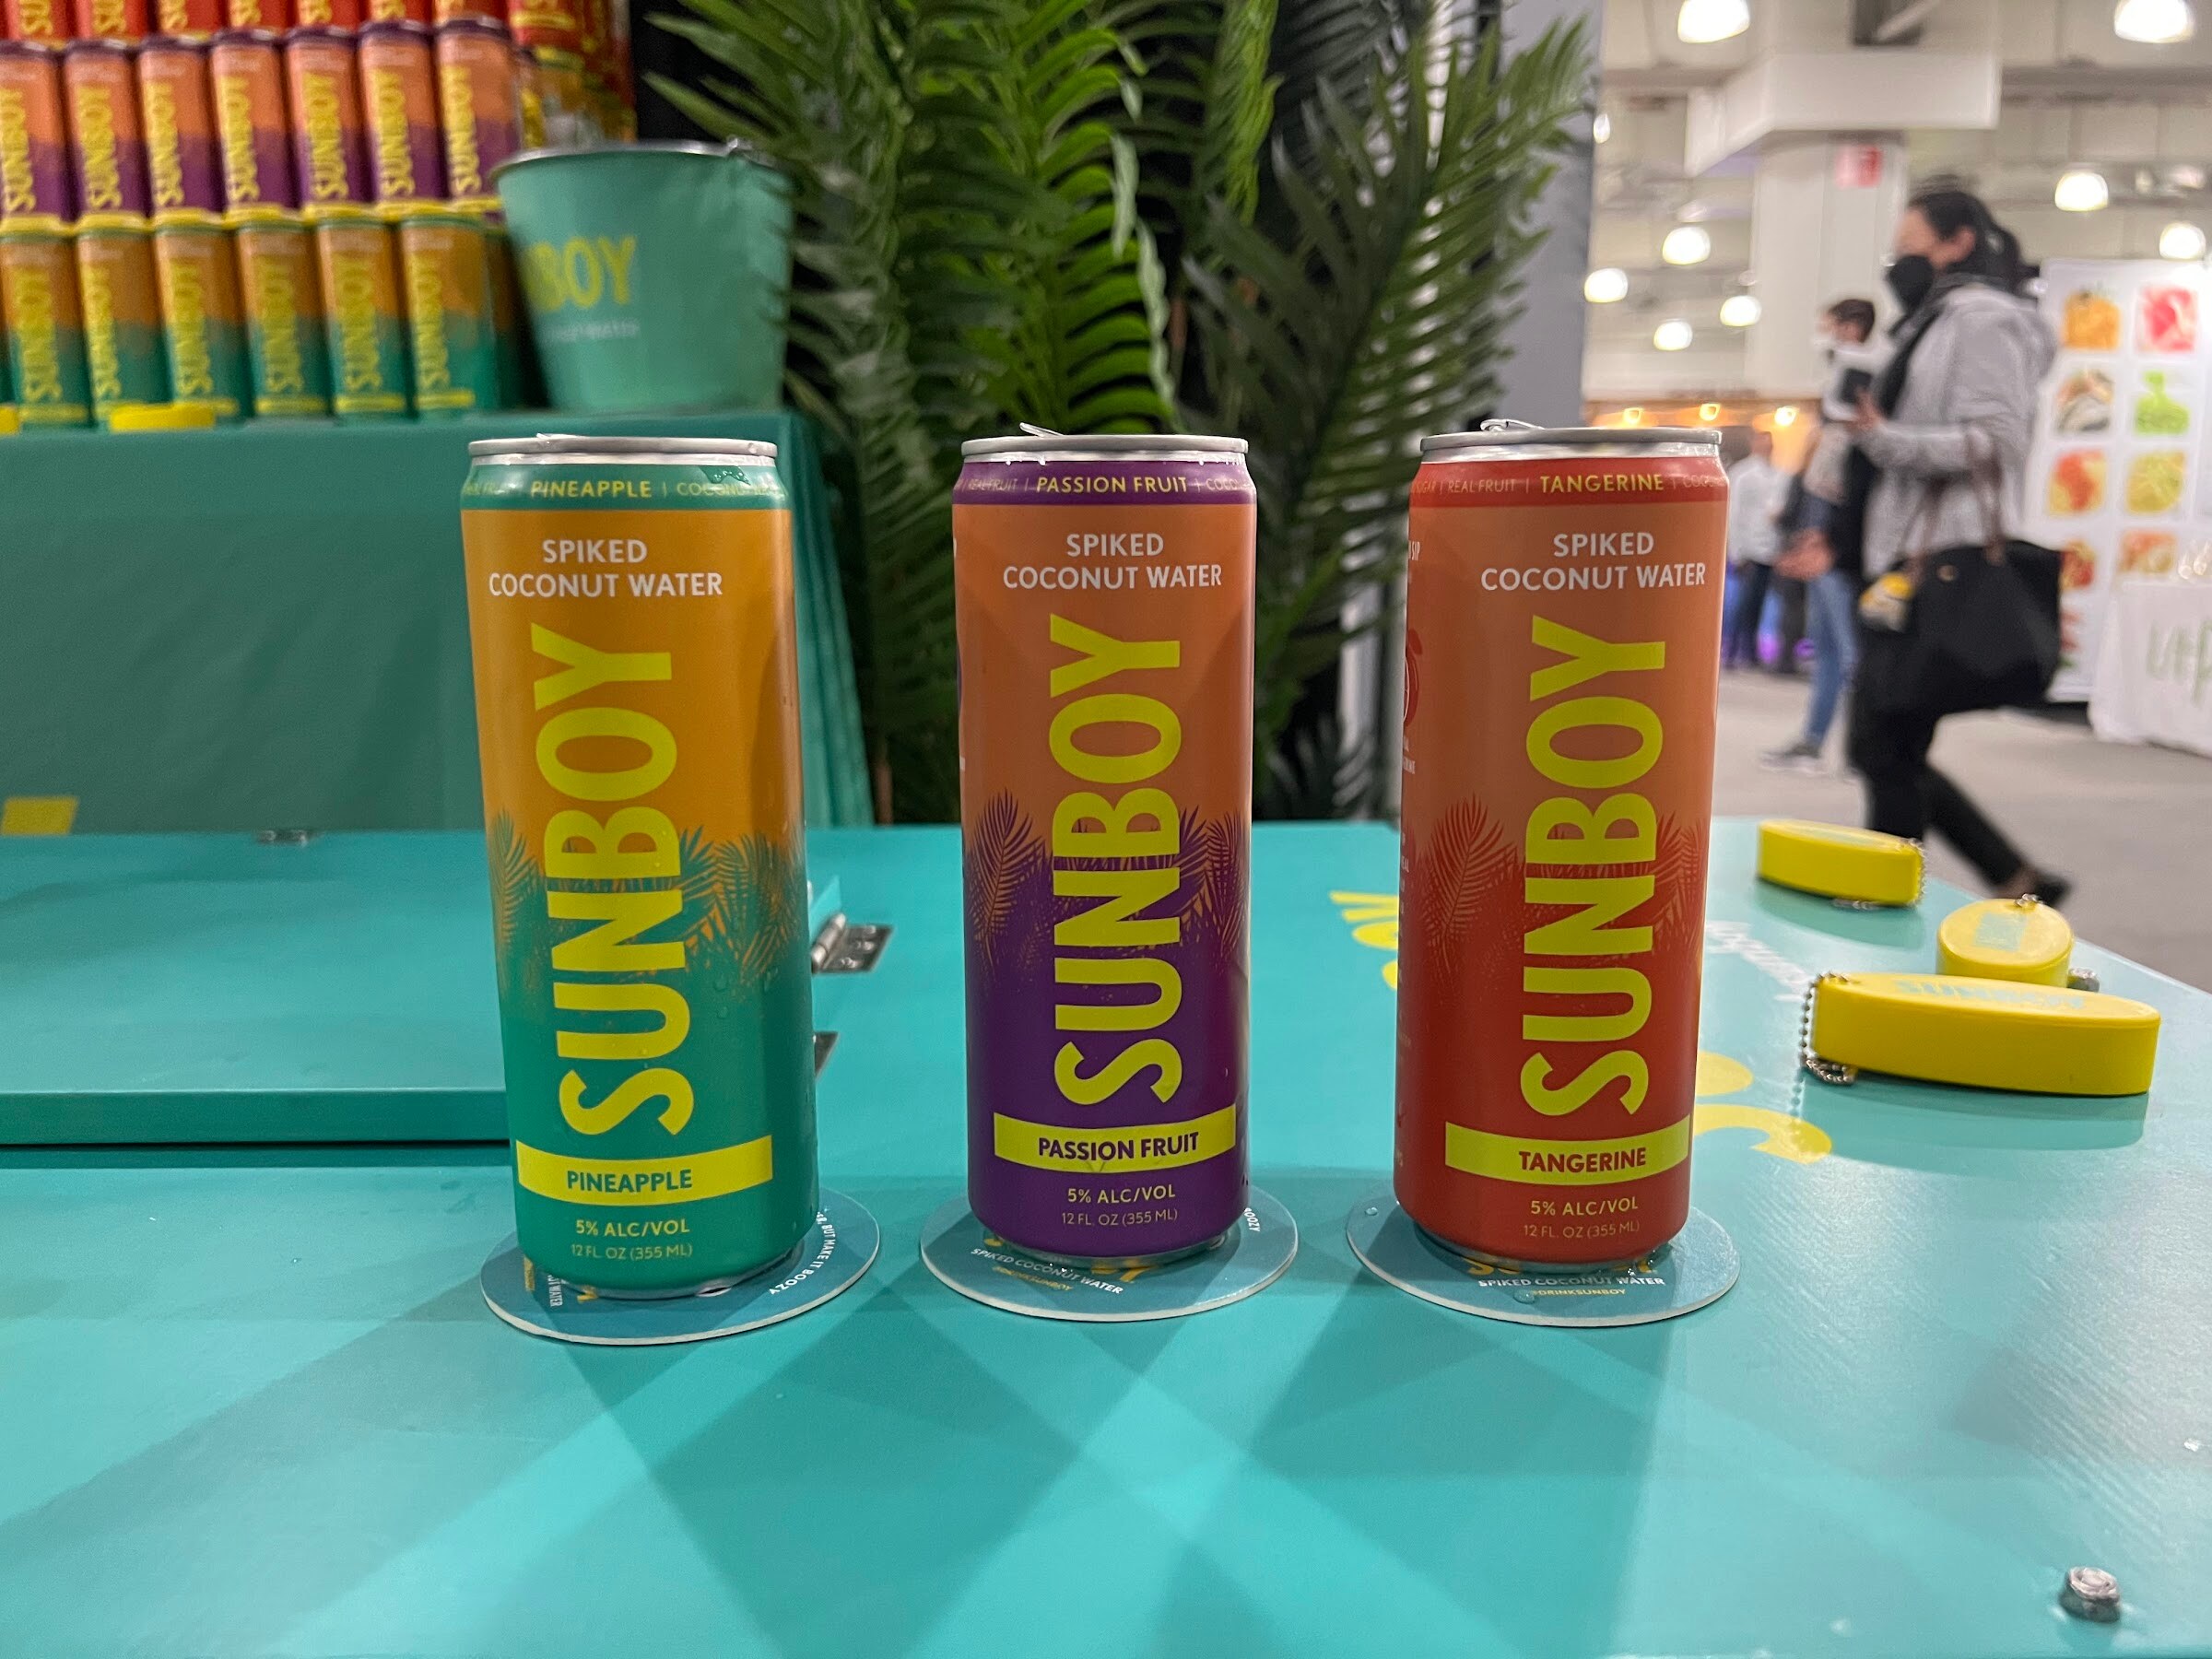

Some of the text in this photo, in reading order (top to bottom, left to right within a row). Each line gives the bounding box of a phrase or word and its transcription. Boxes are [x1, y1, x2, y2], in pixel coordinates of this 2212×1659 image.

[531, 480, 652, 498] PINEAPPLE
[1036, 477, 1125, 493] PASSION
[1134, 477, 1187, 493] FRUIT
[1448, 480, 1475, 493] REAL
[1478, 478, 1516, 492] FRUIT
[1540, 474, 1664, 493] TANGERINE
[542, 539, 648, 564] SPIKED
[1066, 533, 1164, 558] SPIKED
[1553, 532, 1654, 558] SPIKED
[489, 572, 723, 597] COCONUT WATER
[1003, 564, 1222, 590] COCONUT WATER
[1481, 563, 1705, 591] COCONUT WATER
[1049, 613, 1182, 1105] SUNBOY
[1520, 615, 1666, 1115] SUNBOY
[531, 622, 694, 1135] SUNBOY
[1038, 1132, 1199, 1161] PASSION FRUIT
[1519, 1147, 1647, 1173] TANGERINE
[567, 1169, 692, 1194] PINEAPPLE
[1067, 1183, 1176, 1204] 5% ALC/VOL
[1062, 1213, 1075, 1224] 12
[1099, 1214, 1119, 1226] OZ
[1122, 1211, 1152, 1227] (355
[1155, 1208, 1178, 1222] ML)
[1531, 1196, 1639, 1216] 5% ALC/VOL
[576, 1218, 690, 1237] 5% ALC/VOL
[821, 1224, 836, 1238] BUT
[1524, 1225, 1537, 1236] 12
[1562, 1227, 1583, 1238] OZ
[1587, 1224, 1617, 1239] (355
[1619, 1220, 1640, 1233] ML)
[571, 1244, 582, 1257] 12
[606, 1247, 627, 1261] OZ
[630, 1247, 663, 1261] (355
[666, 1243, 694, 1258] ML)
[817, 1239, 836, 1260] MAKE
[769, 1268, 815, 1295] BOOZY
[971, 1248, 1014, 1264] SPIKED
[1015, 1258, 1081, 1281] COCONUT
[1080, 1276, 1124, 1294] WATER
[1535, 1277, 1613, 1287] COCONUT
[1616, 1277, 1666, 1286] WATER
